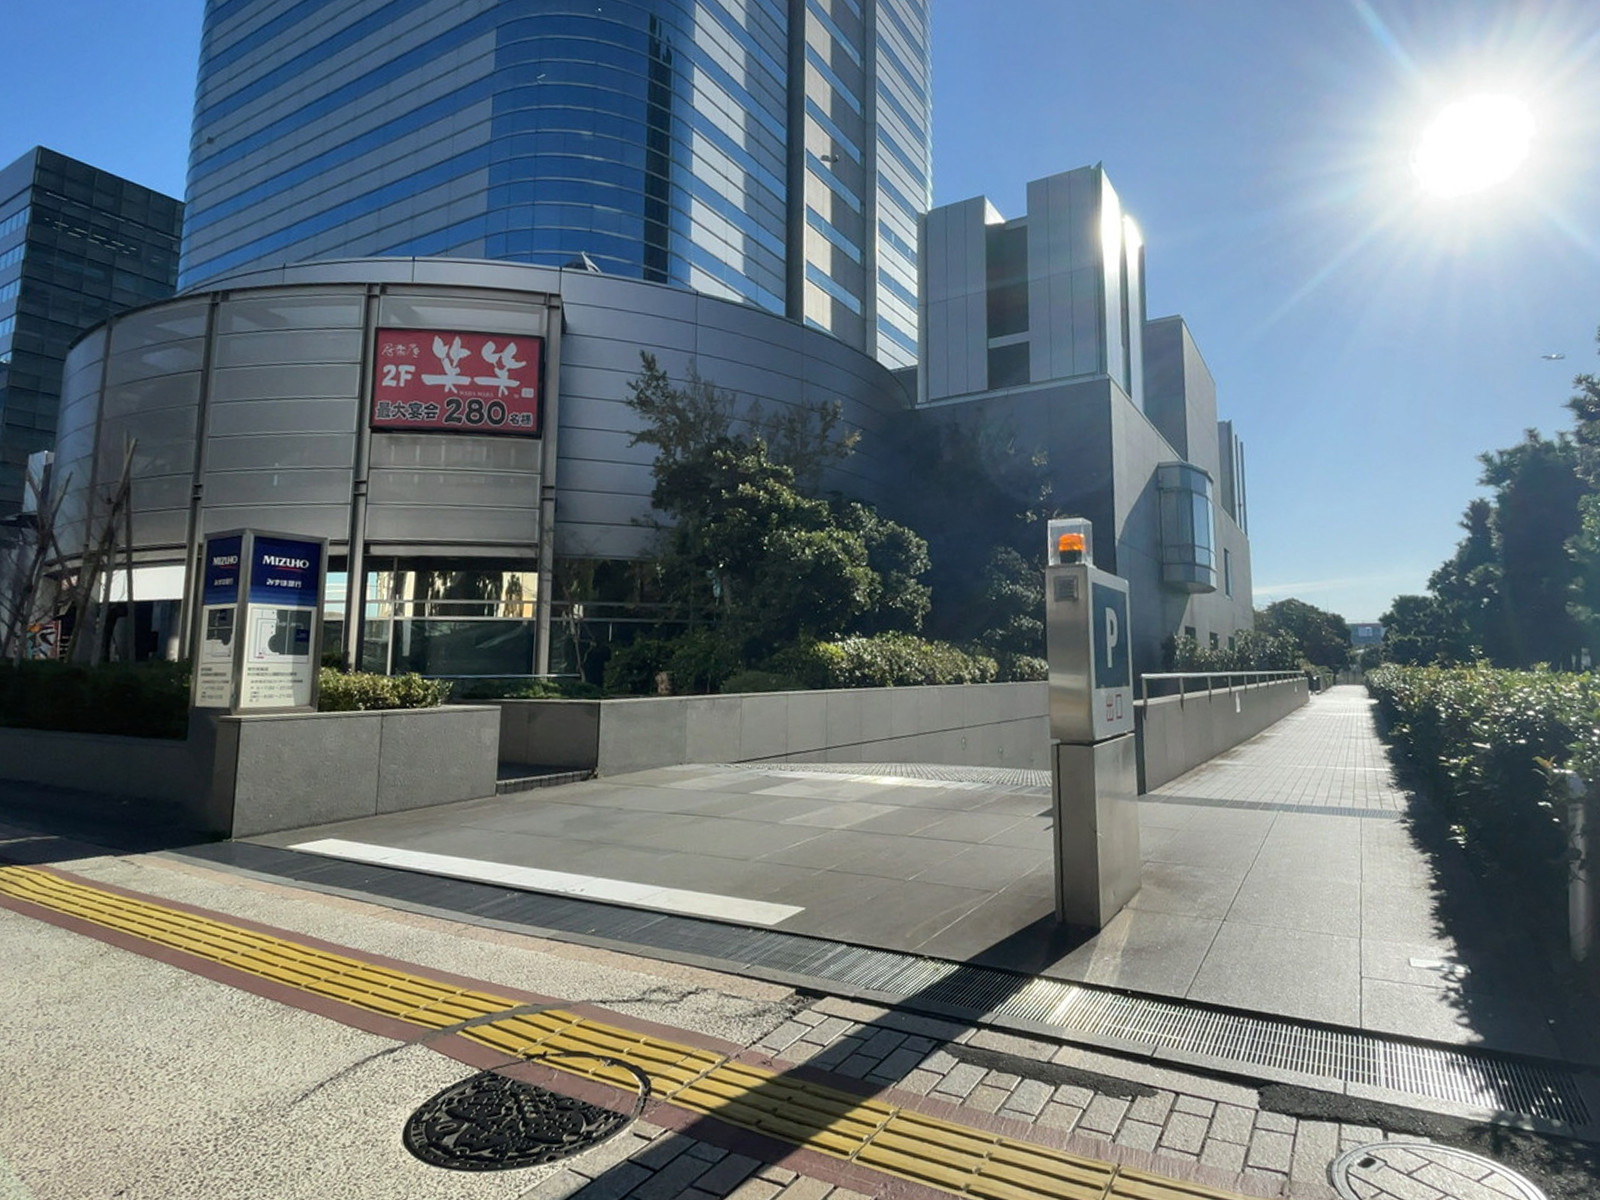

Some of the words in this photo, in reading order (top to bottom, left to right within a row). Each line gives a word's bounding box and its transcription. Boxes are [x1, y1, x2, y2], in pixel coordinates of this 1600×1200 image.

[381, 364, 416, 387] 2F
[375, 400, 440, 420] 最大宴会
[443, 396, 508, 427] 280
[213, 555, 239, 566] MIZUHO
[262, 555, 310, 569] MIZUHO
[1105, 606, 1118, 669] P
